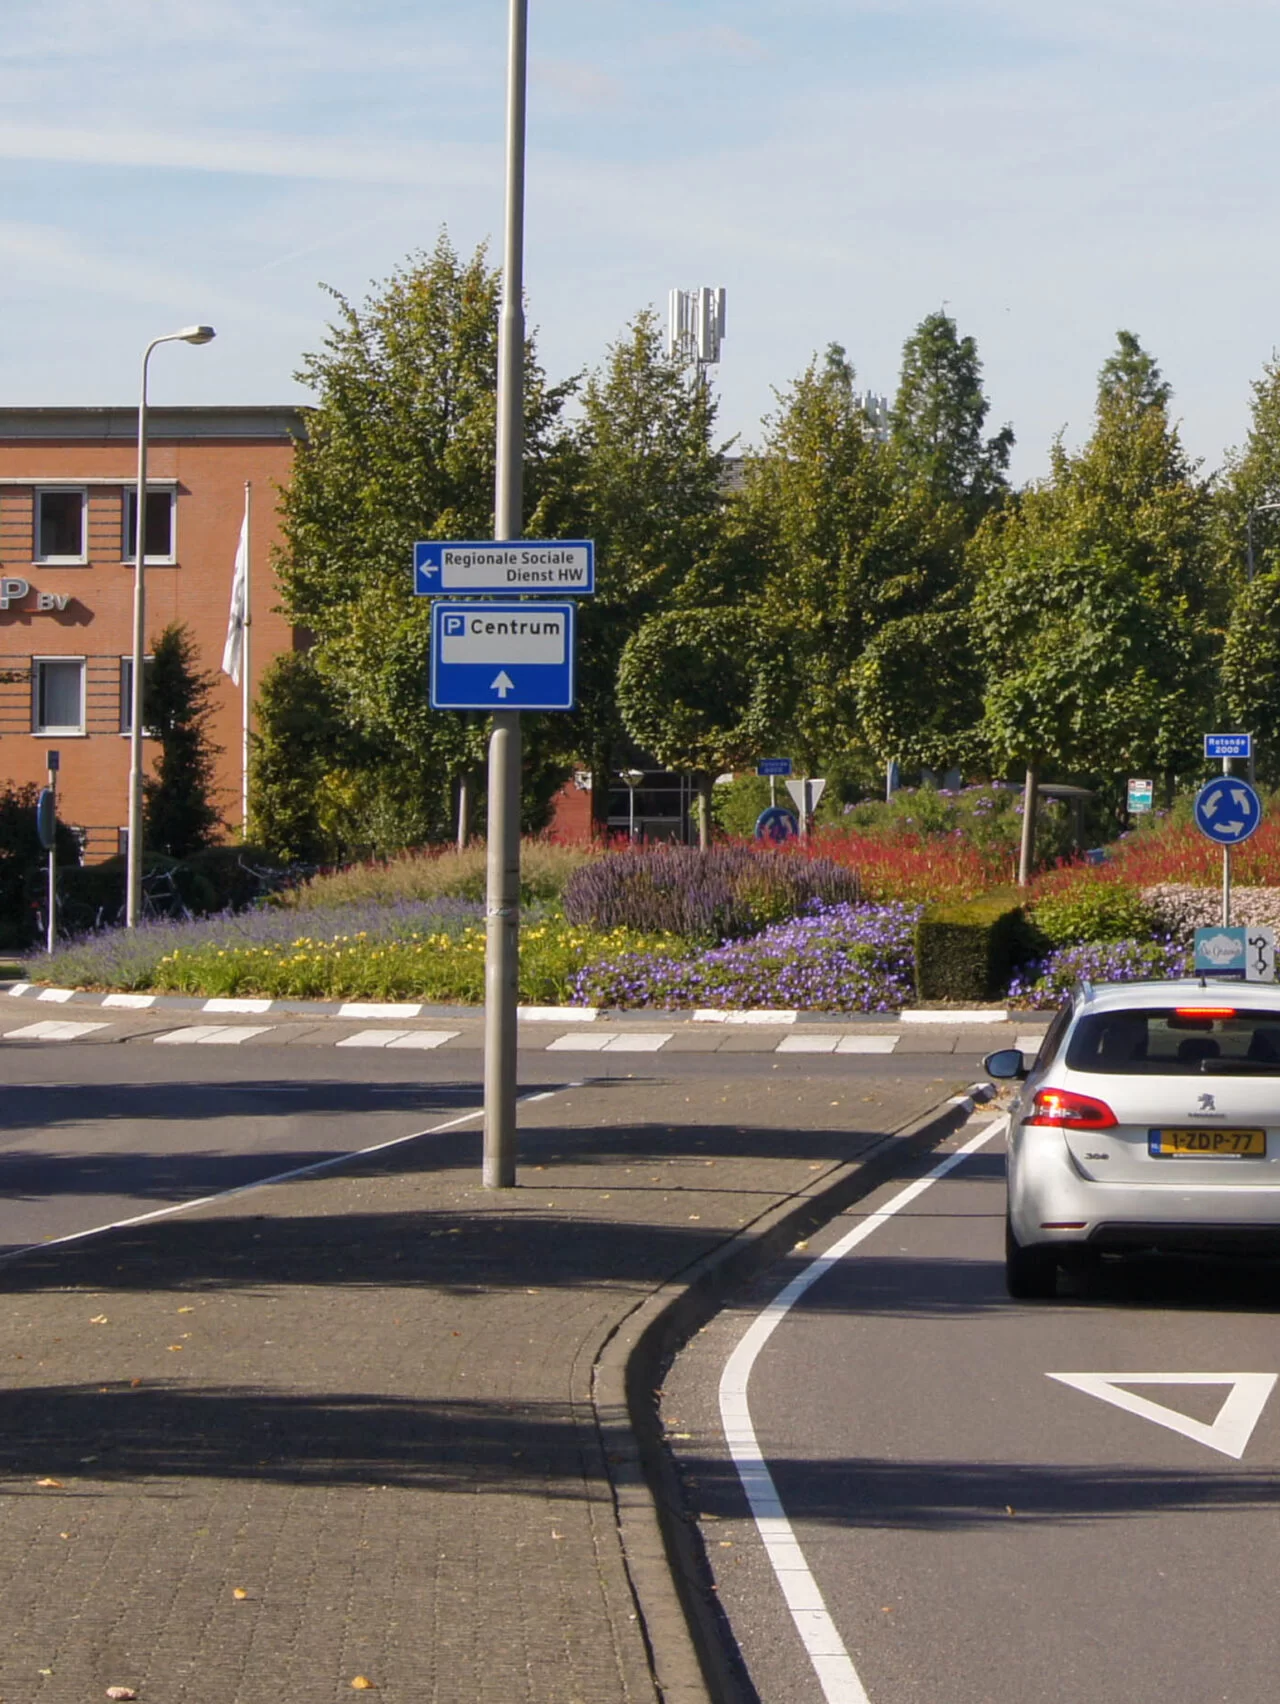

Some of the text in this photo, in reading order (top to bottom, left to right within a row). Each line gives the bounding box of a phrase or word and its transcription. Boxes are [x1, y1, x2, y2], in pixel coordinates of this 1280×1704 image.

[444, 551, 574, 568] Regionale Sociale
[506, 568, 584, 582] Dienst HW
[37, 592, 69, 611] BV
[447, 618, 560, 635] P Centrum
[1215, 746, 1239, 754] 2000
[1171, 1133, 1253, 1150] 1-ZDP-77
